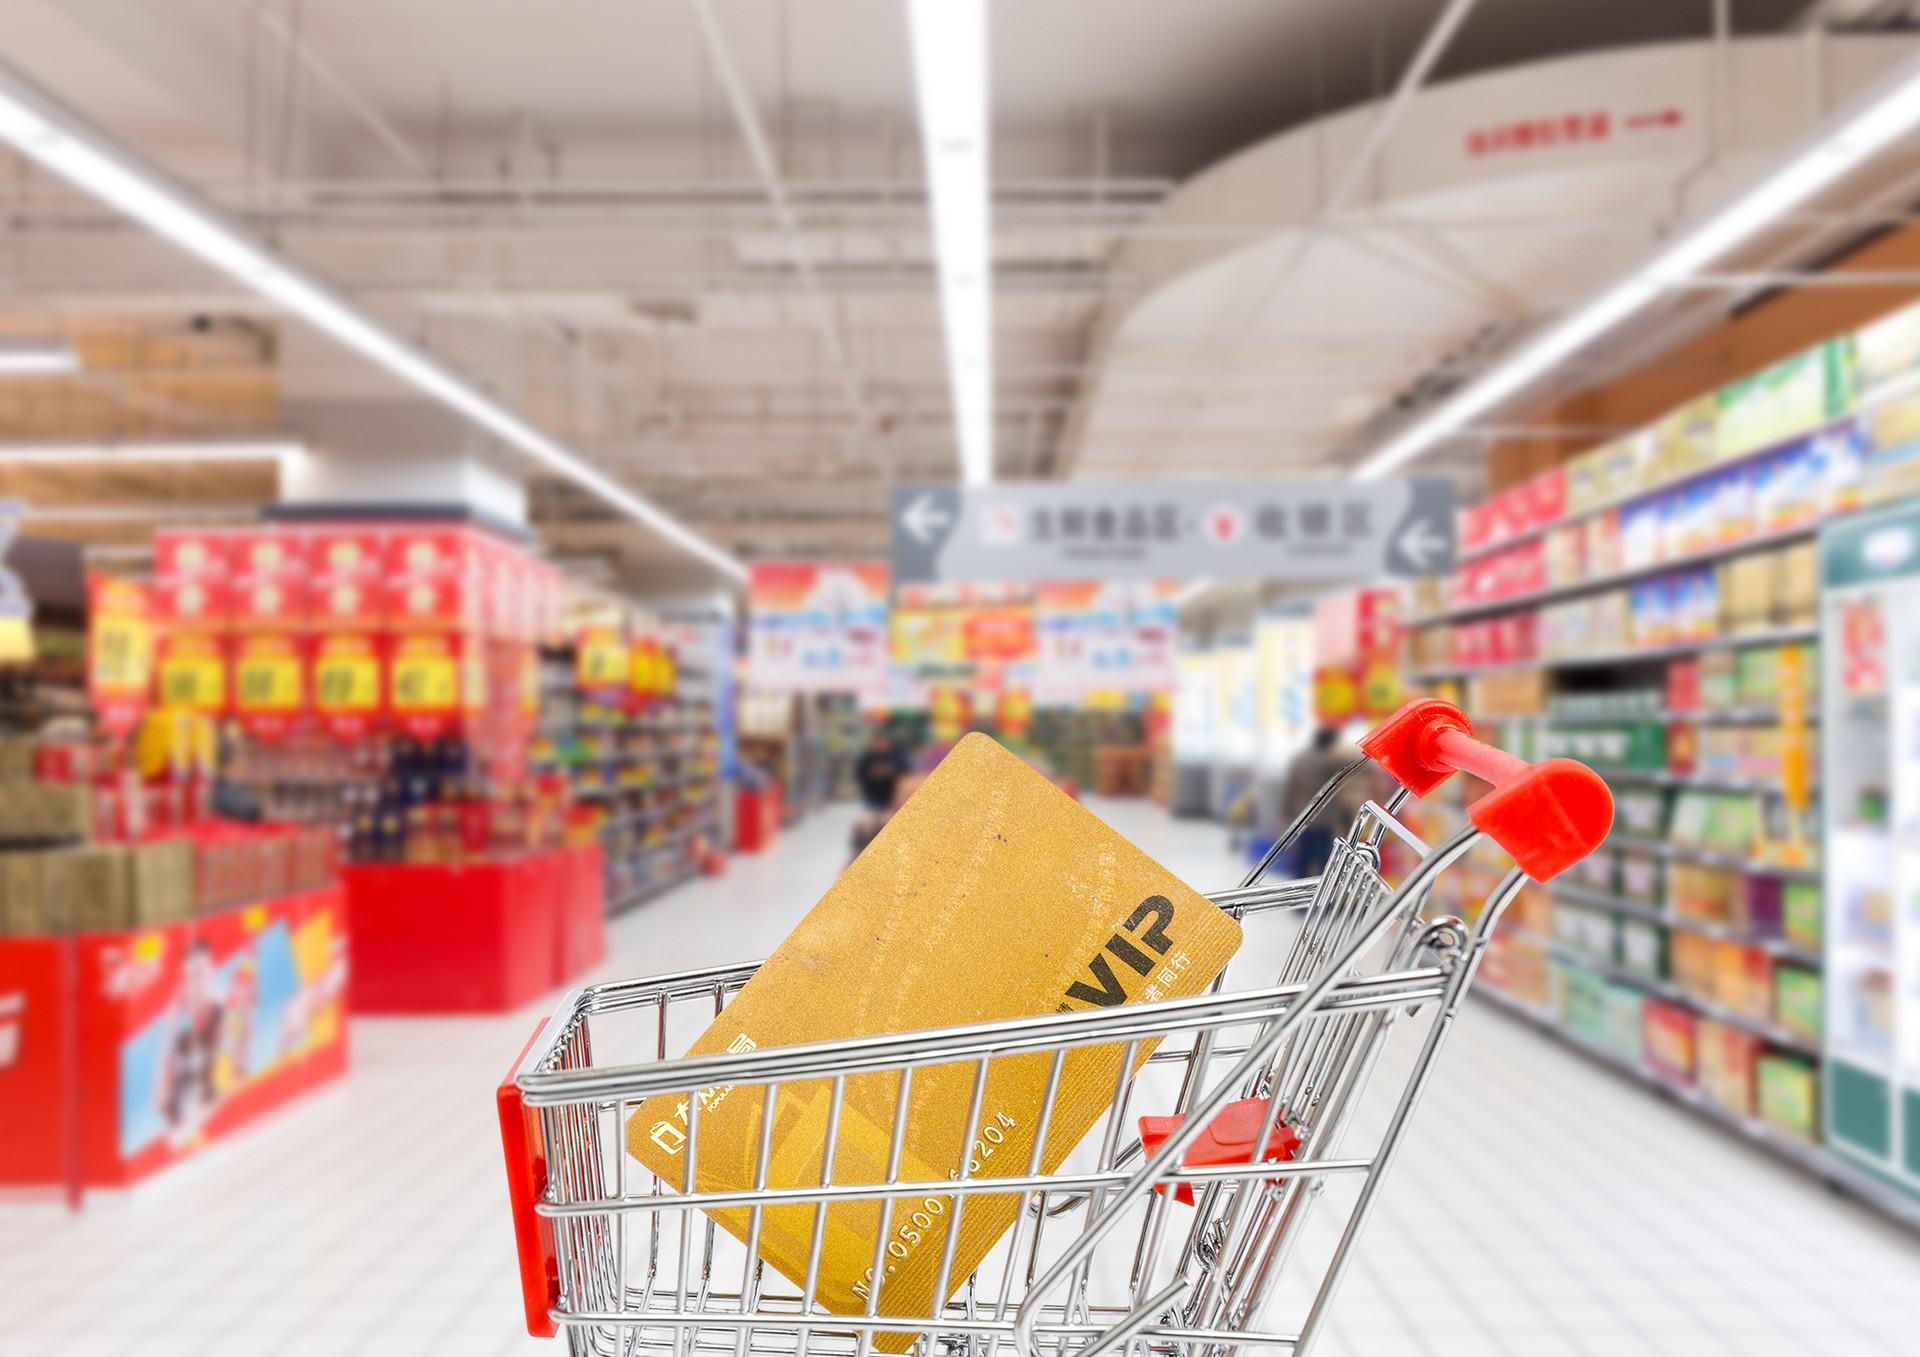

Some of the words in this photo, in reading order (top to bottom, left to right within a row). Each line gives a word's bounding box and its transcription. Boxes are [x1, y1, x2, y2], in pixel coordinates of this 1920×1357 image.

[1065, 895, 1175, 1008] VIP
[1138, 952, 1191, 1003] 者同行
[674, 1033, 757, 1126] 大众局
[851, 1112, 1017, 1304] NO.0500204
